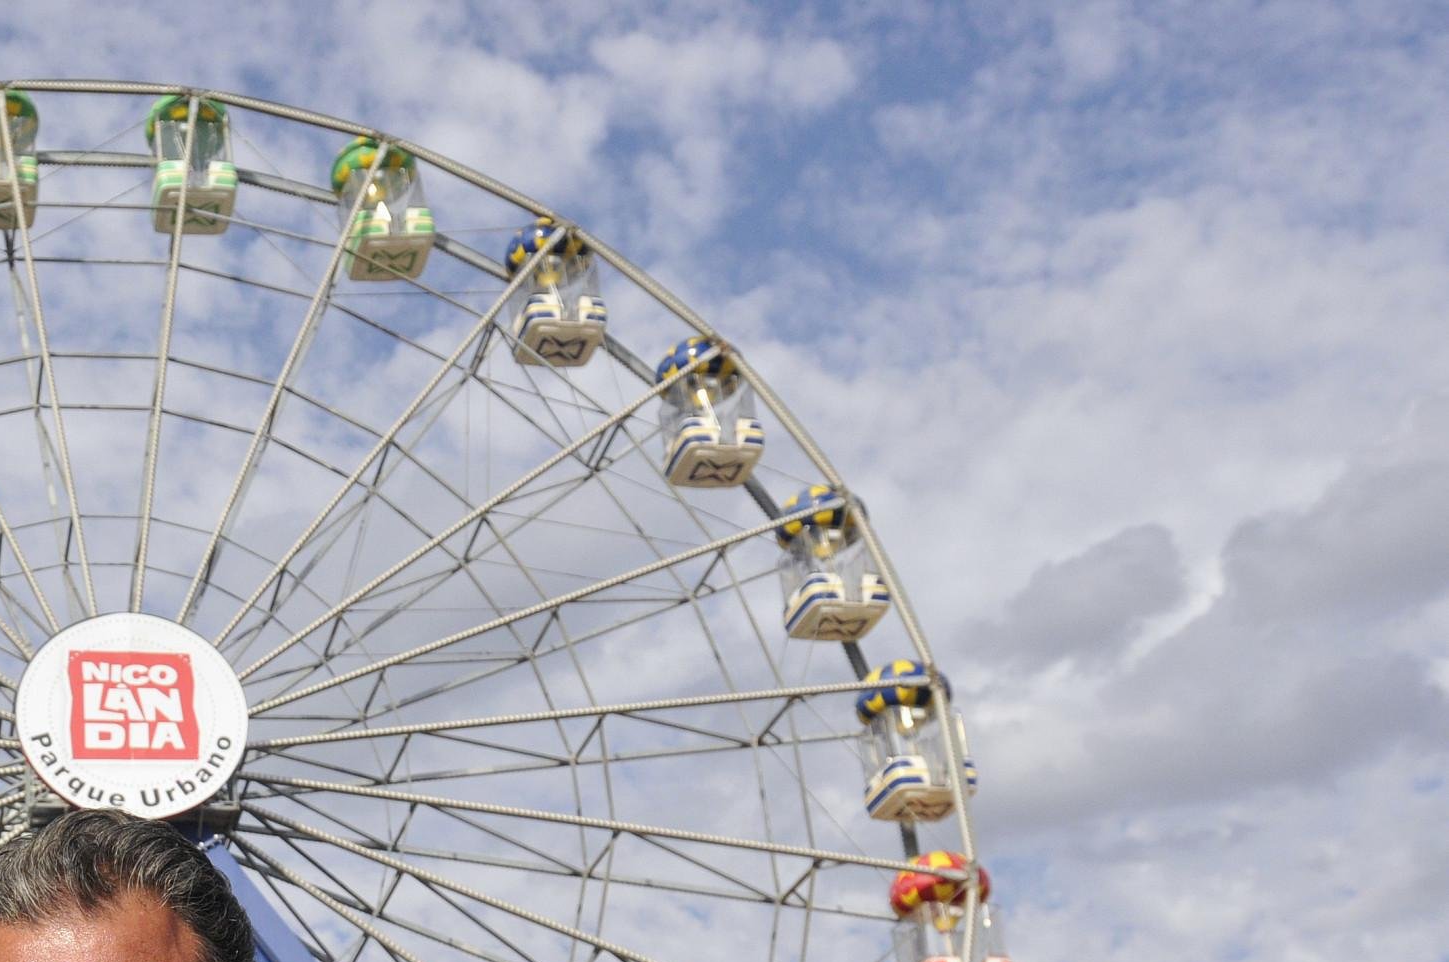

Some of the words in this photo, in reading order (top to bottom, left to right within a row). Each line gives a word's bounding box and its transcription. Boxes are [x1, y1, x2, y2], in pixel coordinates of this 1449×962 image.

[84, 722, 186, 750] DIA
[31, 731, 126, 807] Parque
[140, 736, 232, 808] Urbano
